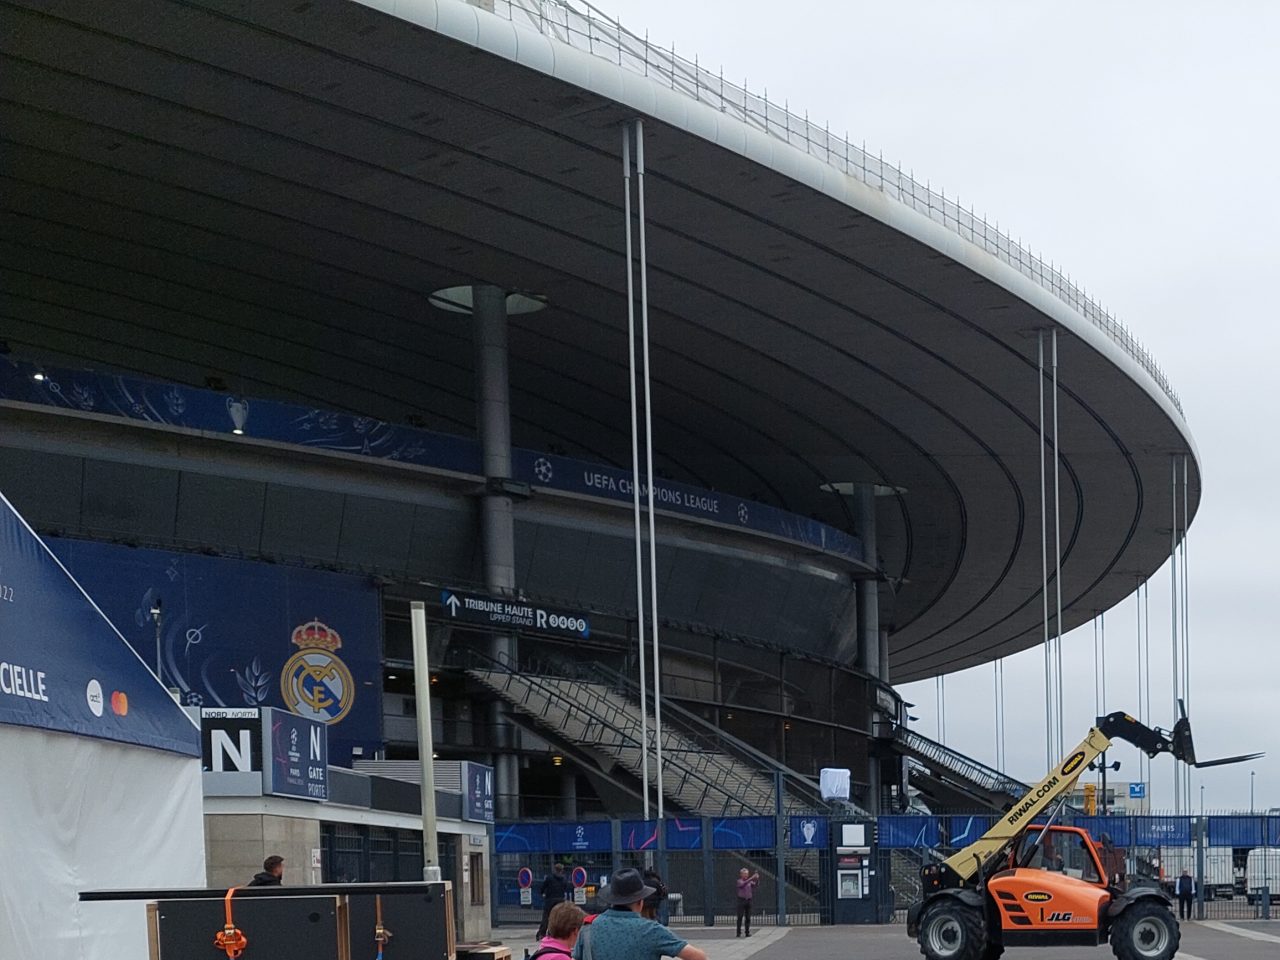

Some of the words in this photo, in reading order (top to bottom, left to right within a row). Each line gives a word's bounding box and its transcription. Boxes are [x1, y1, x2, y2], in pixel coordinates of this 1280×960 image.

[584, 471, 616, 491] UEFA
[684, 493, 719, 513] LEAGUE
[464, 598, 503, 613] TRIBUNE
[505, 604, 533, 618] HAUTE
[490, 613, 511, 623] UPPER
[511, 615, 534, 626] STAND
[536, 609, 547, 629] R
[0, 661, 49, 703] CIELLE
[205, 711, 228, 719] NORD
[231, 711, 257, 719] NORTH
[211, 729, 252, 772] N
[310, 724, 321, 761] N
[308, 766, 324, 780] GATE
[485, 770, 491, 796] N
[307, 782, 326, 798] PORTE
[1151, 824, 1175, 832] PARIS
[1047, 912, 1073, 922] JLG
